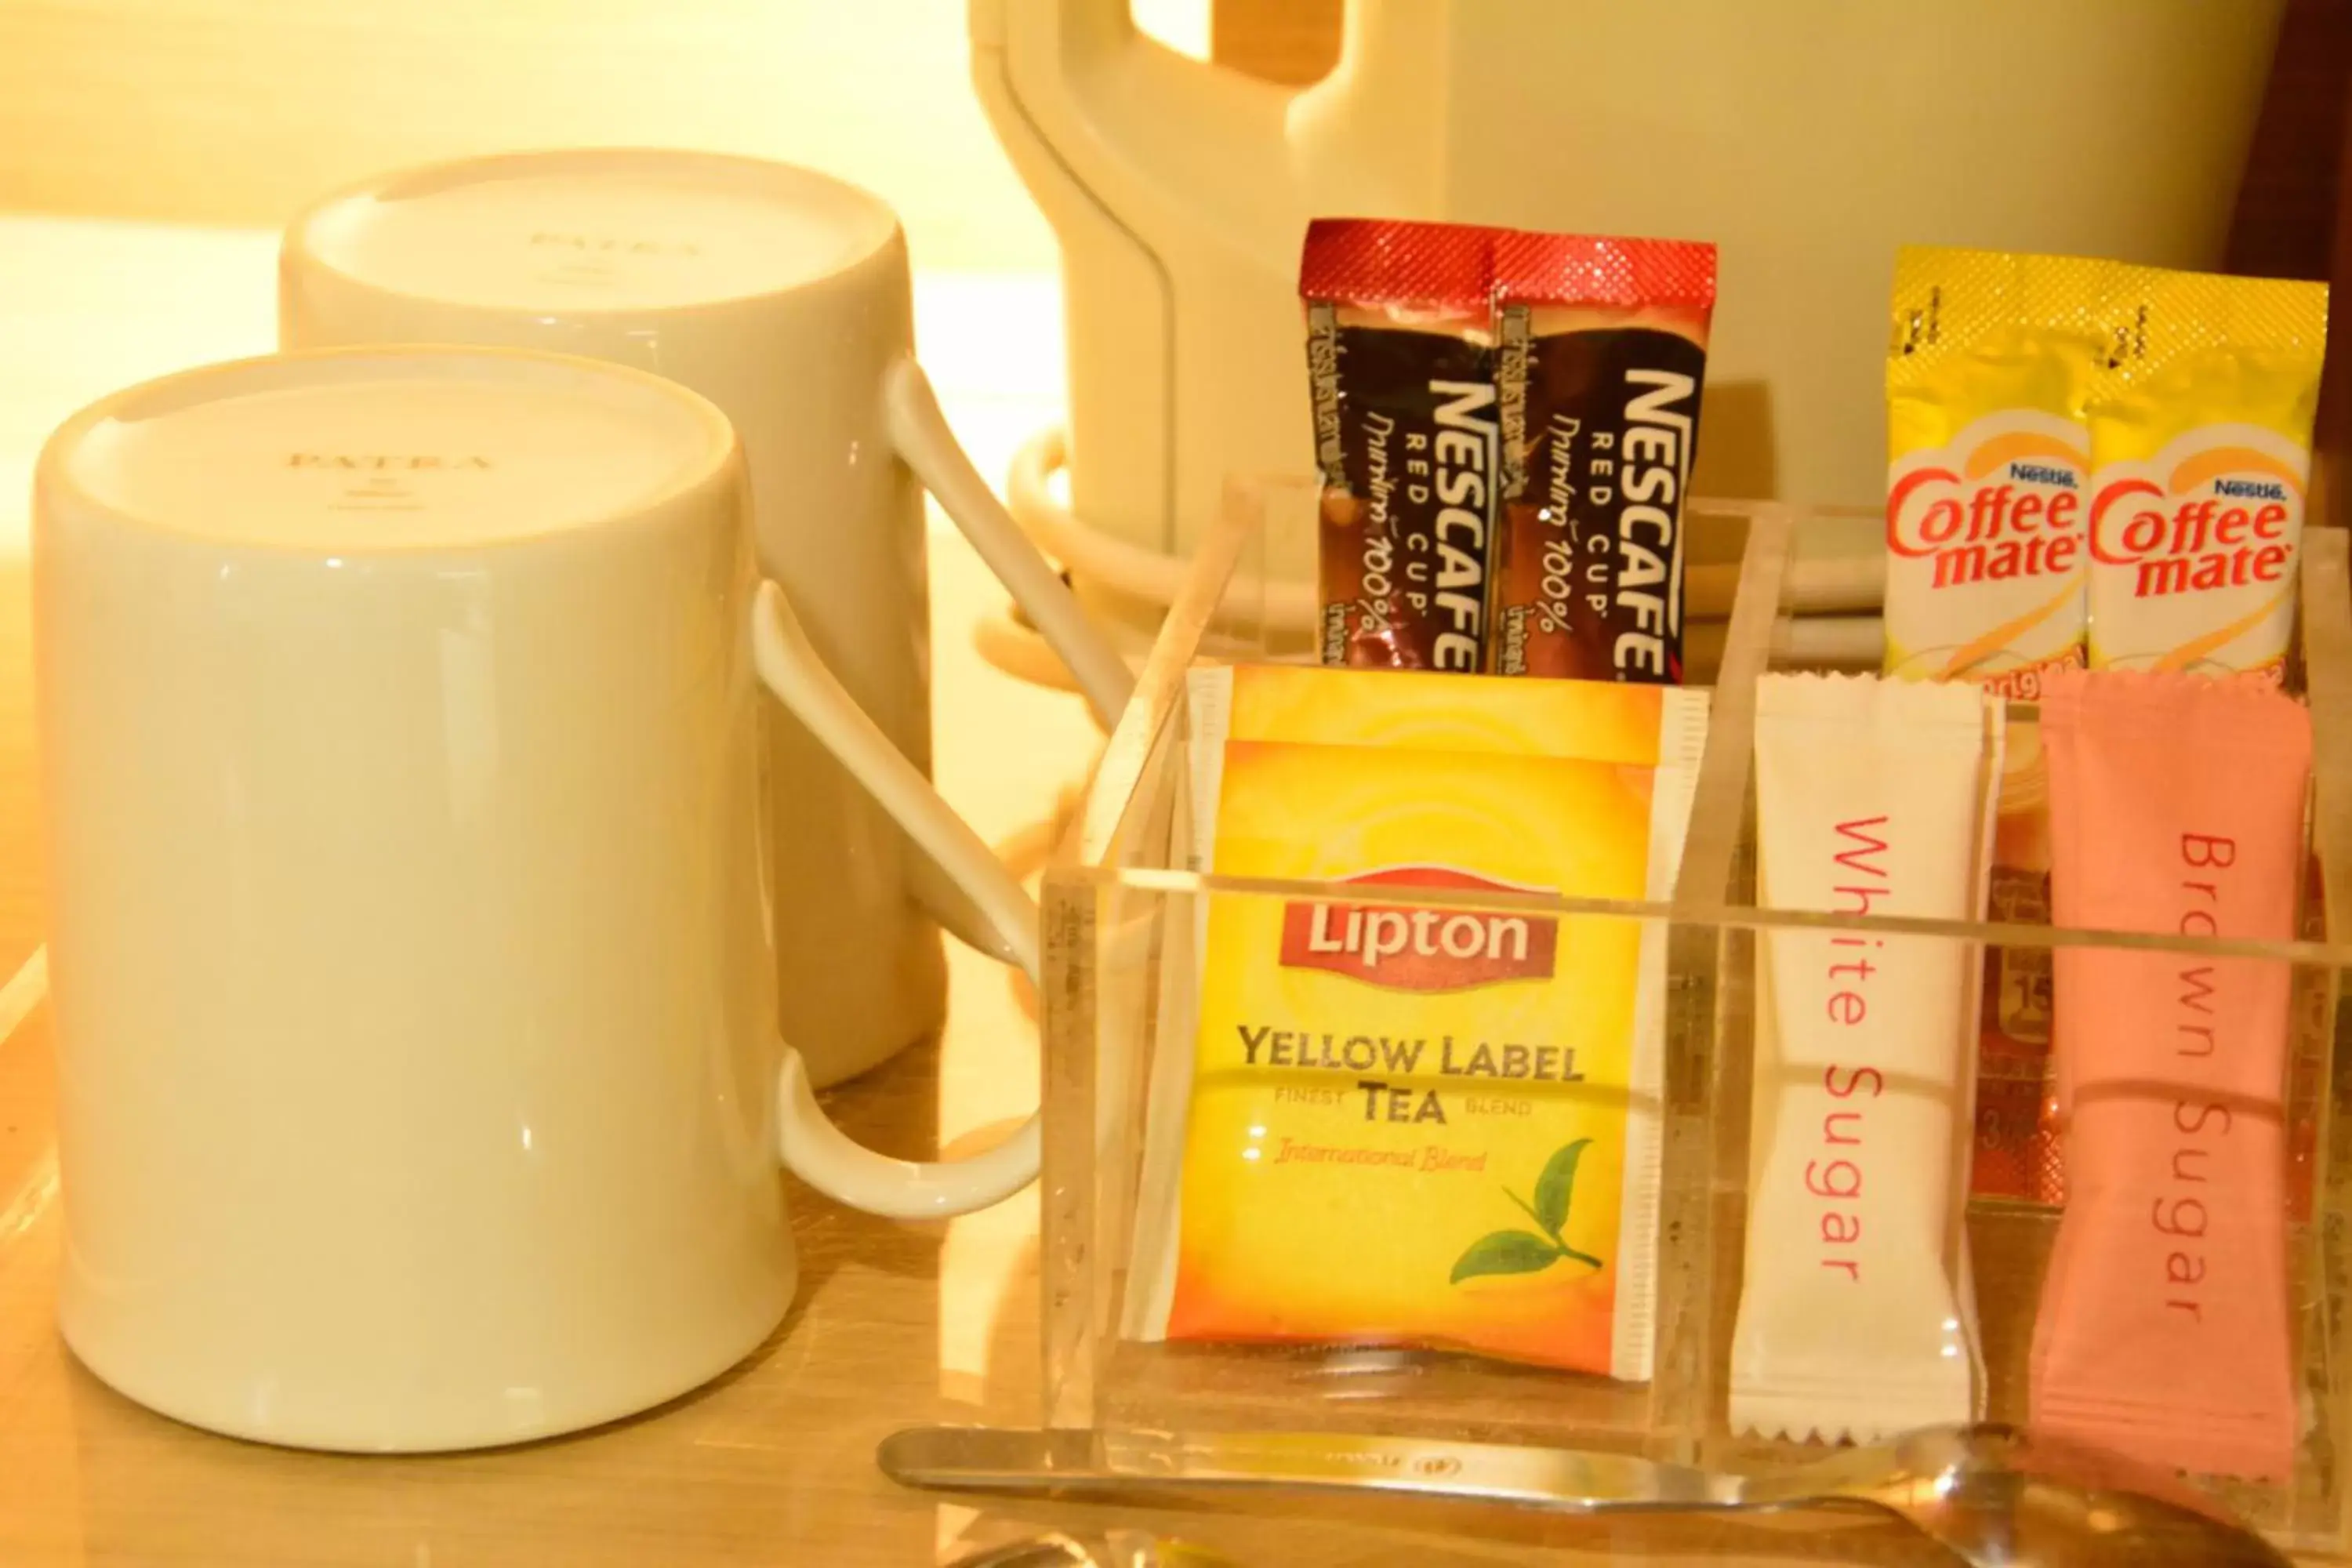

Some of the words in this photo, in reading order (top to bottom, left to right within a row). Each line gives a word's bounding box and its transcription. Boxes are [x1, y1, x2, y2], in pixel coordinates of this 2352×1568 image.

[282, 452, 494, 470] PATRA
[1405, 433, 1428, 504] RED
[1590, 432, 1613, 505] RED
[1887, 467, 2079, 558] Coffee
[2089, 477, 2287, 565] Coffee
[1357, 536, 1394, 633] 100%
[1406, 534, 1428, 611] CUP
[1541, 539, 1574, 634] 100%
[1587, 534, 1610, 612] CUP
[1931, 535, 2078, 589] mate
[2134, 543, 2288, 598] mate
[1308, 902, 1530, 967] Lipton
[1827, 815, 1891, 1026] White
[2176, 831, 2236, 1059] Brown
[1236, 1024, 1425, 1073] YELLOW
[1439, 1035, 1585, 1083] LABEL
[1273, 1086, 1345, 1106] FINEST
[1464, 1098, 1532, 1116] BLEND
[1357, 1080, 1447, 1124] TEA
[1273, 1138, 1417, 1167] International
[1418, 1145, 1487, 1173] Blend
[1806, 1064, 1883, 1283] Sugar
[2151, 1100, 2231, 1323] Sugar
